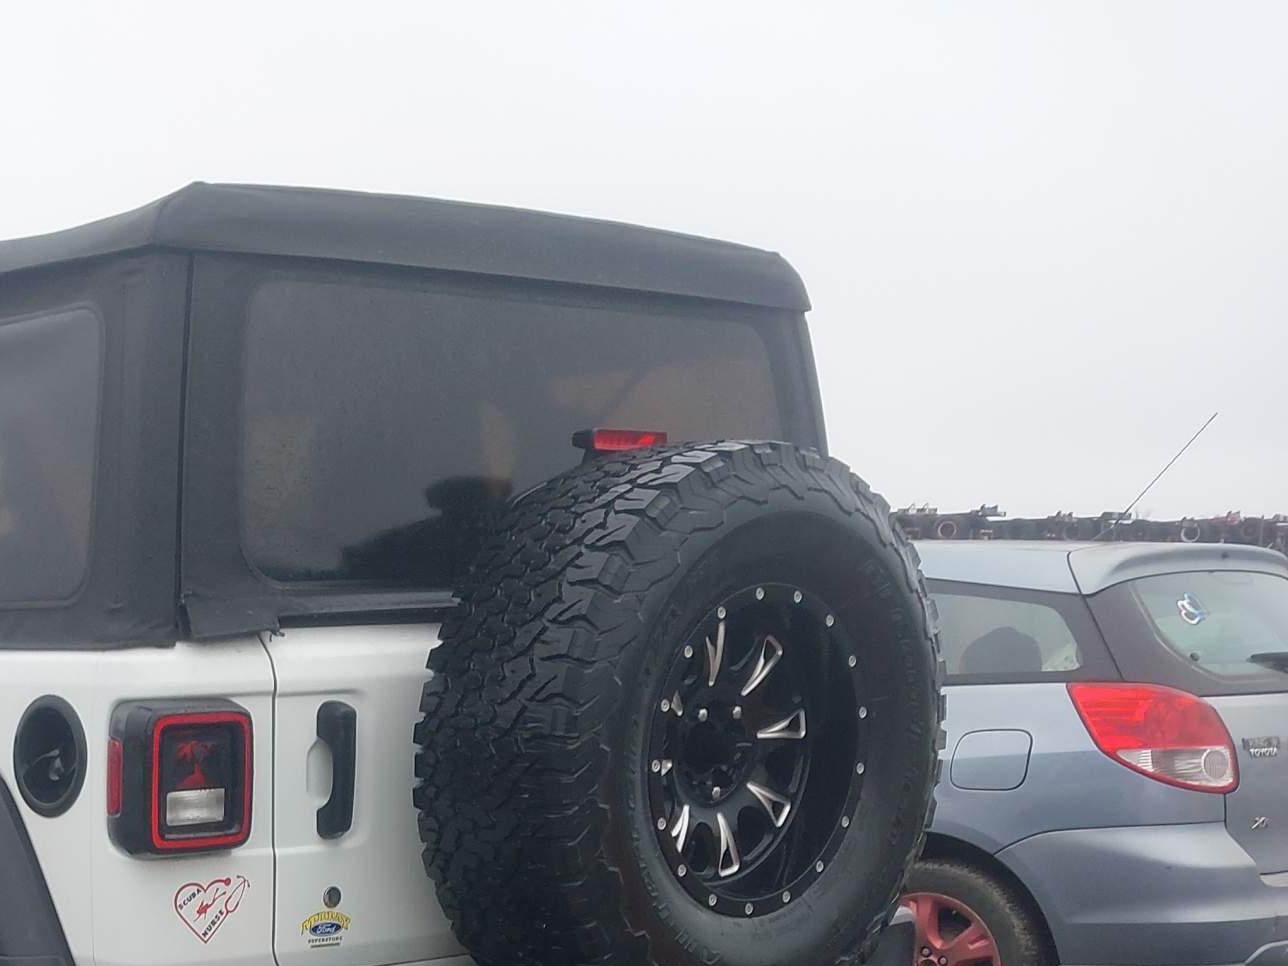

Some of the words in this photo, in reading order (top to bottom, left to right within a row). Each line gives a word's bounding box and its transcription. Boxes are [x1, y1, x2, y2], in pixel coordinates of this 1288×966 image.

[1249, 747, 1278, 758] TOYOTA
[178, 888, 202, 910] SCUBA
[202, 909, 224, 938] NURSE
